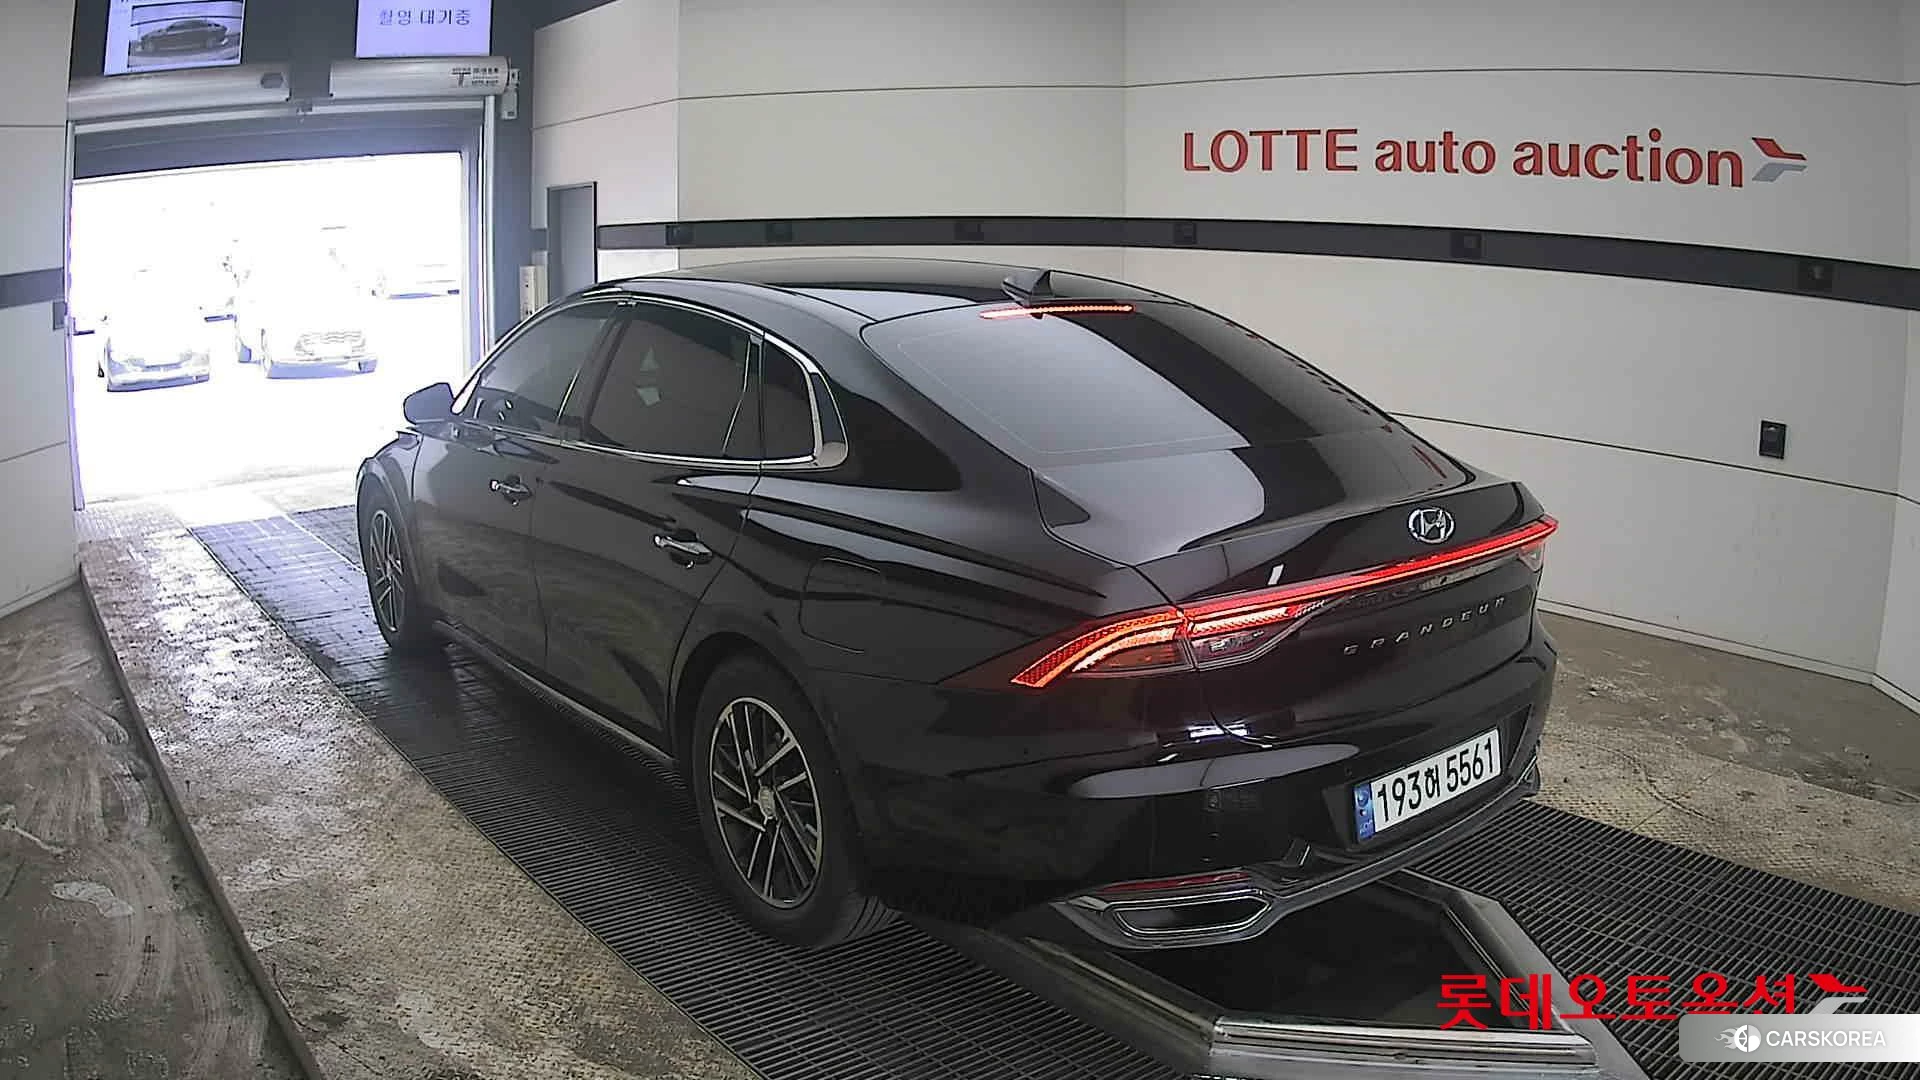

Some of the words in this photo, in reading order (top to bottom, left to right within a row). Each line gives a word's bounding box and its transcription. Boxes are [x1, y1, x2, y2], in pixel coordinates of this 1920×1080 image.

[420, 9, 471, 26] 대기중
[1183, 128, 1358, 173] LOTTE
[1375, 130, 1497, 175] auto
[1512, 127, 1744, 188] auction
[1343, 597, 1505, 655] GRANDEUR
[1377, 764, 1441, 823] 193허
[1446, 737, 1493, 793] 5561
